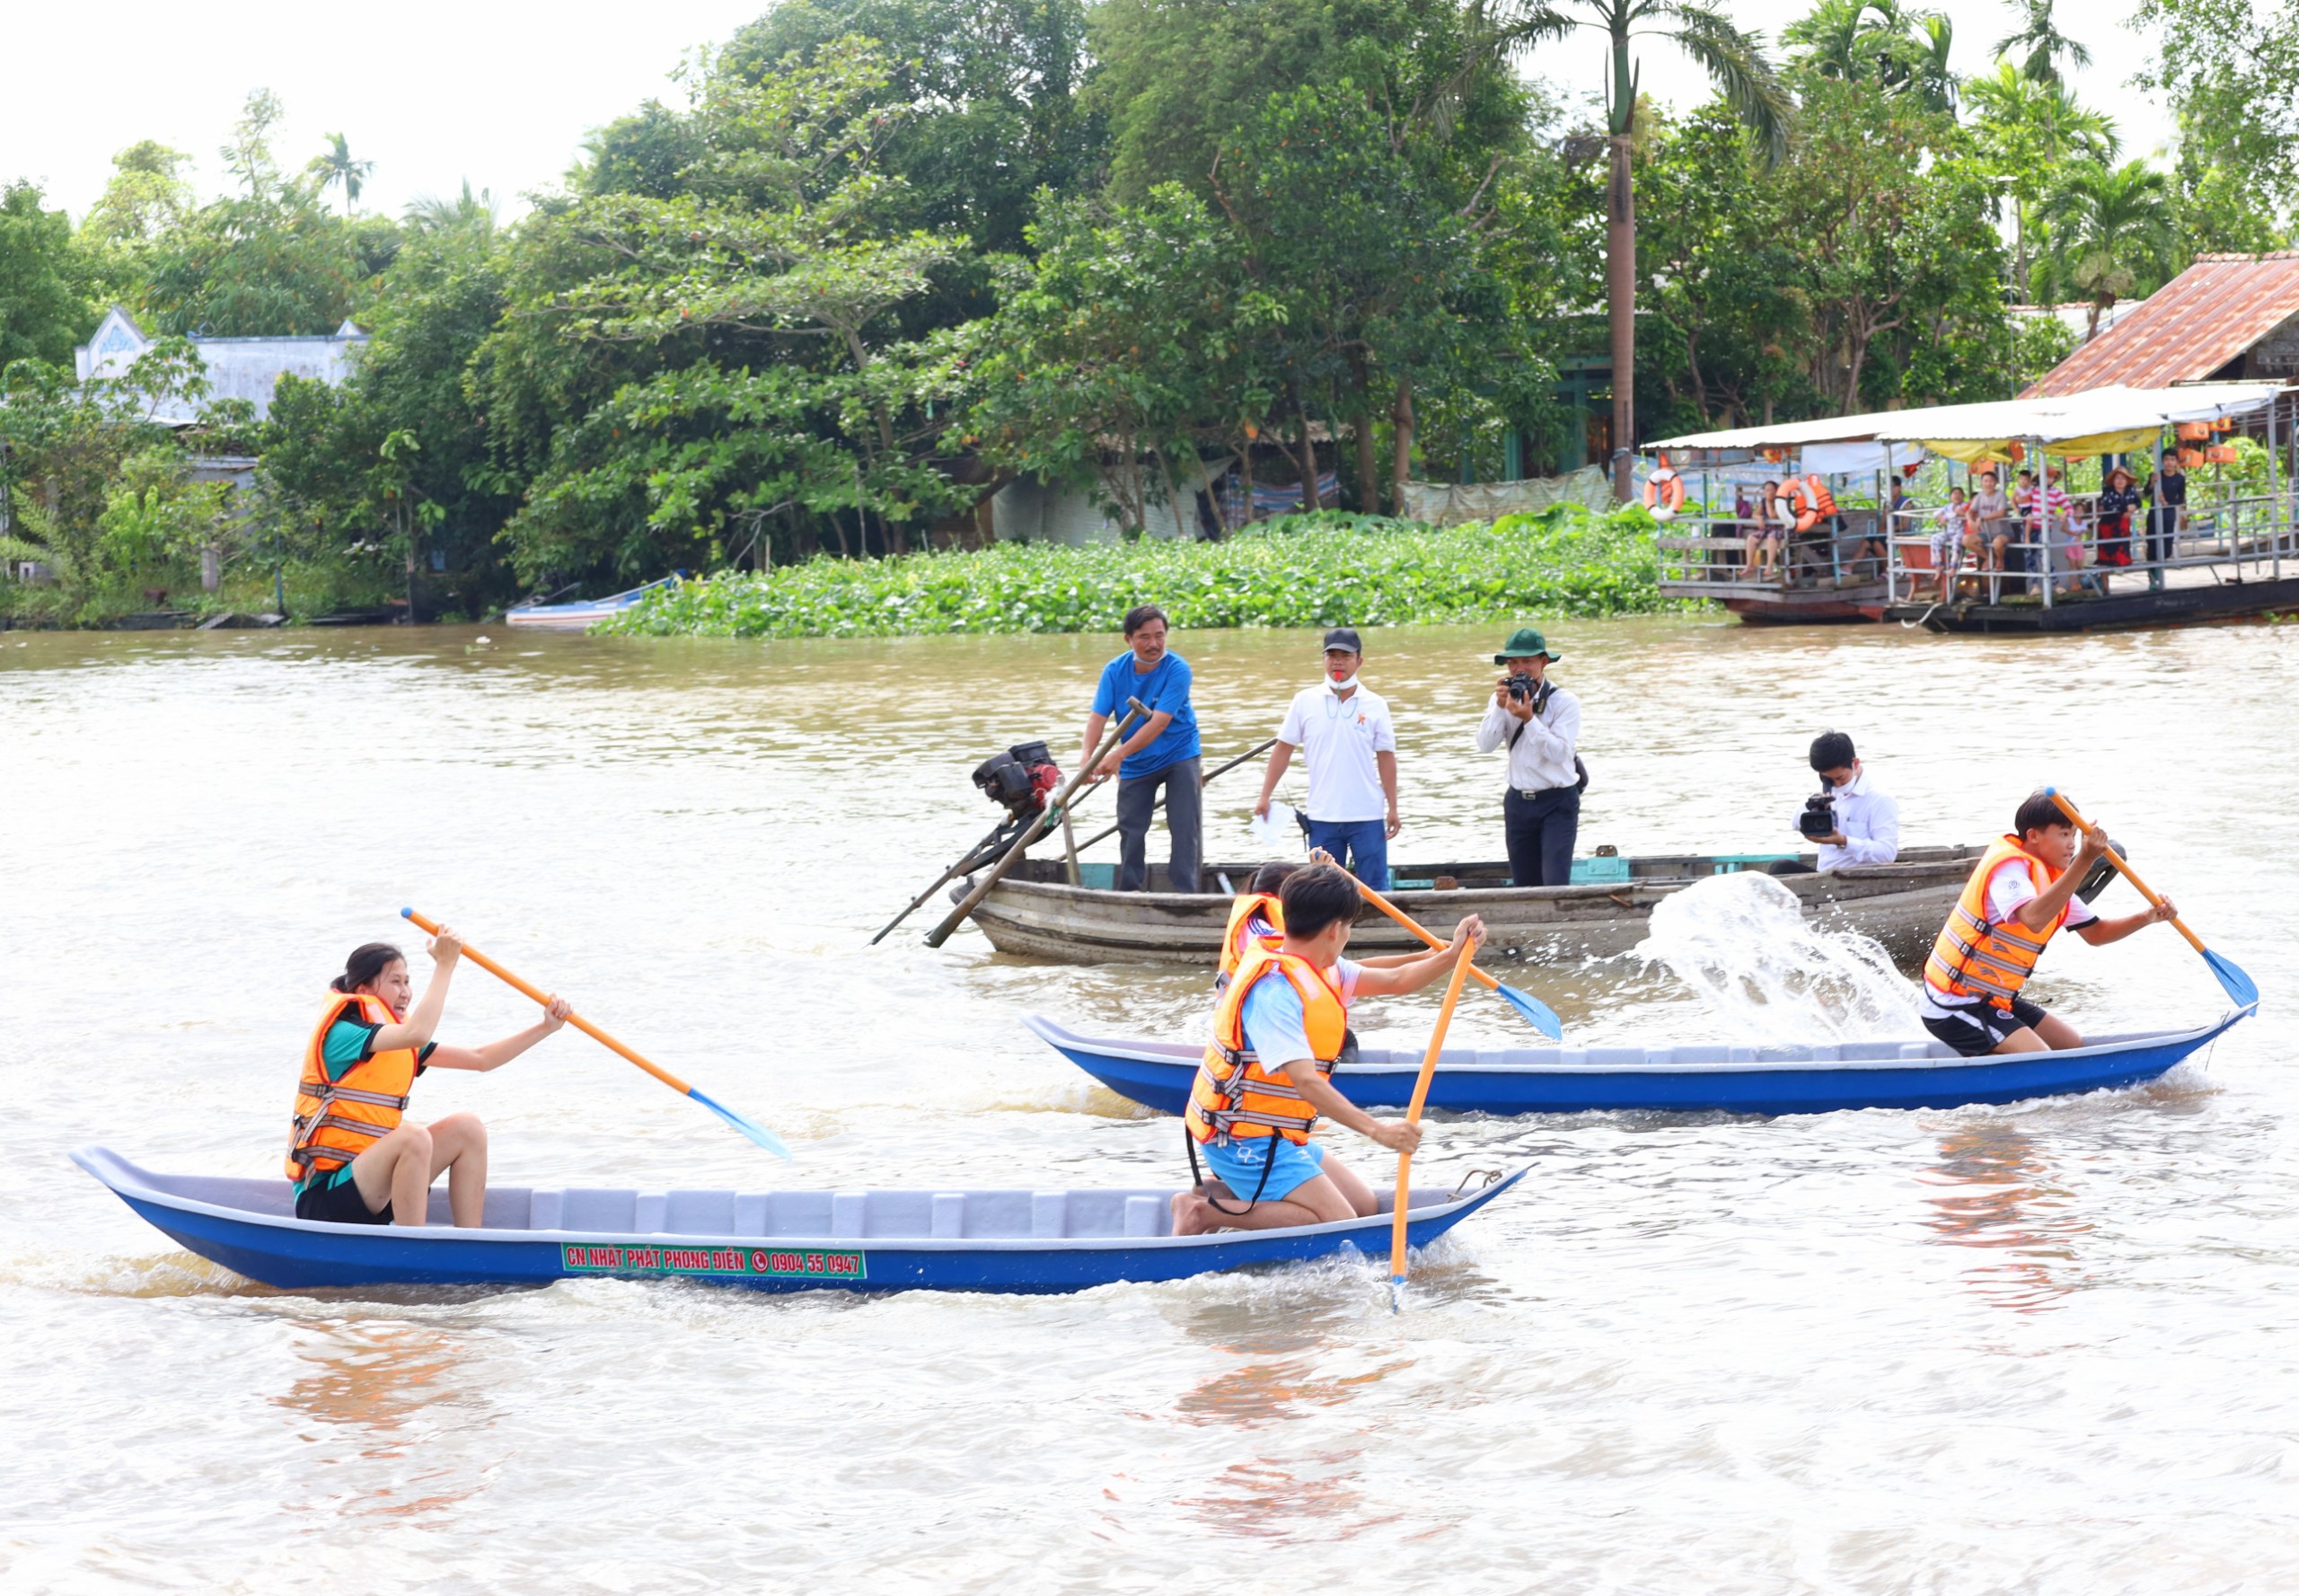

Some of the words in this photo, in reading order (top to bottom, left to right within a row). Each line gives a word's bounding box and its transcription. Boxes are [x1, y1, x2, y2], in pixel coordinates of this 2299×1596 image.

[567, 1247, 586, 1265] CN
[627, 1246, 660, 1267] PHÁT
[664, 1249, 710, 1270] PHONG
[771, 1253, 804, 1272] 0904
[806, 1254, 824, 1273] 55
[827, 1255, 859, 1274] 0947
